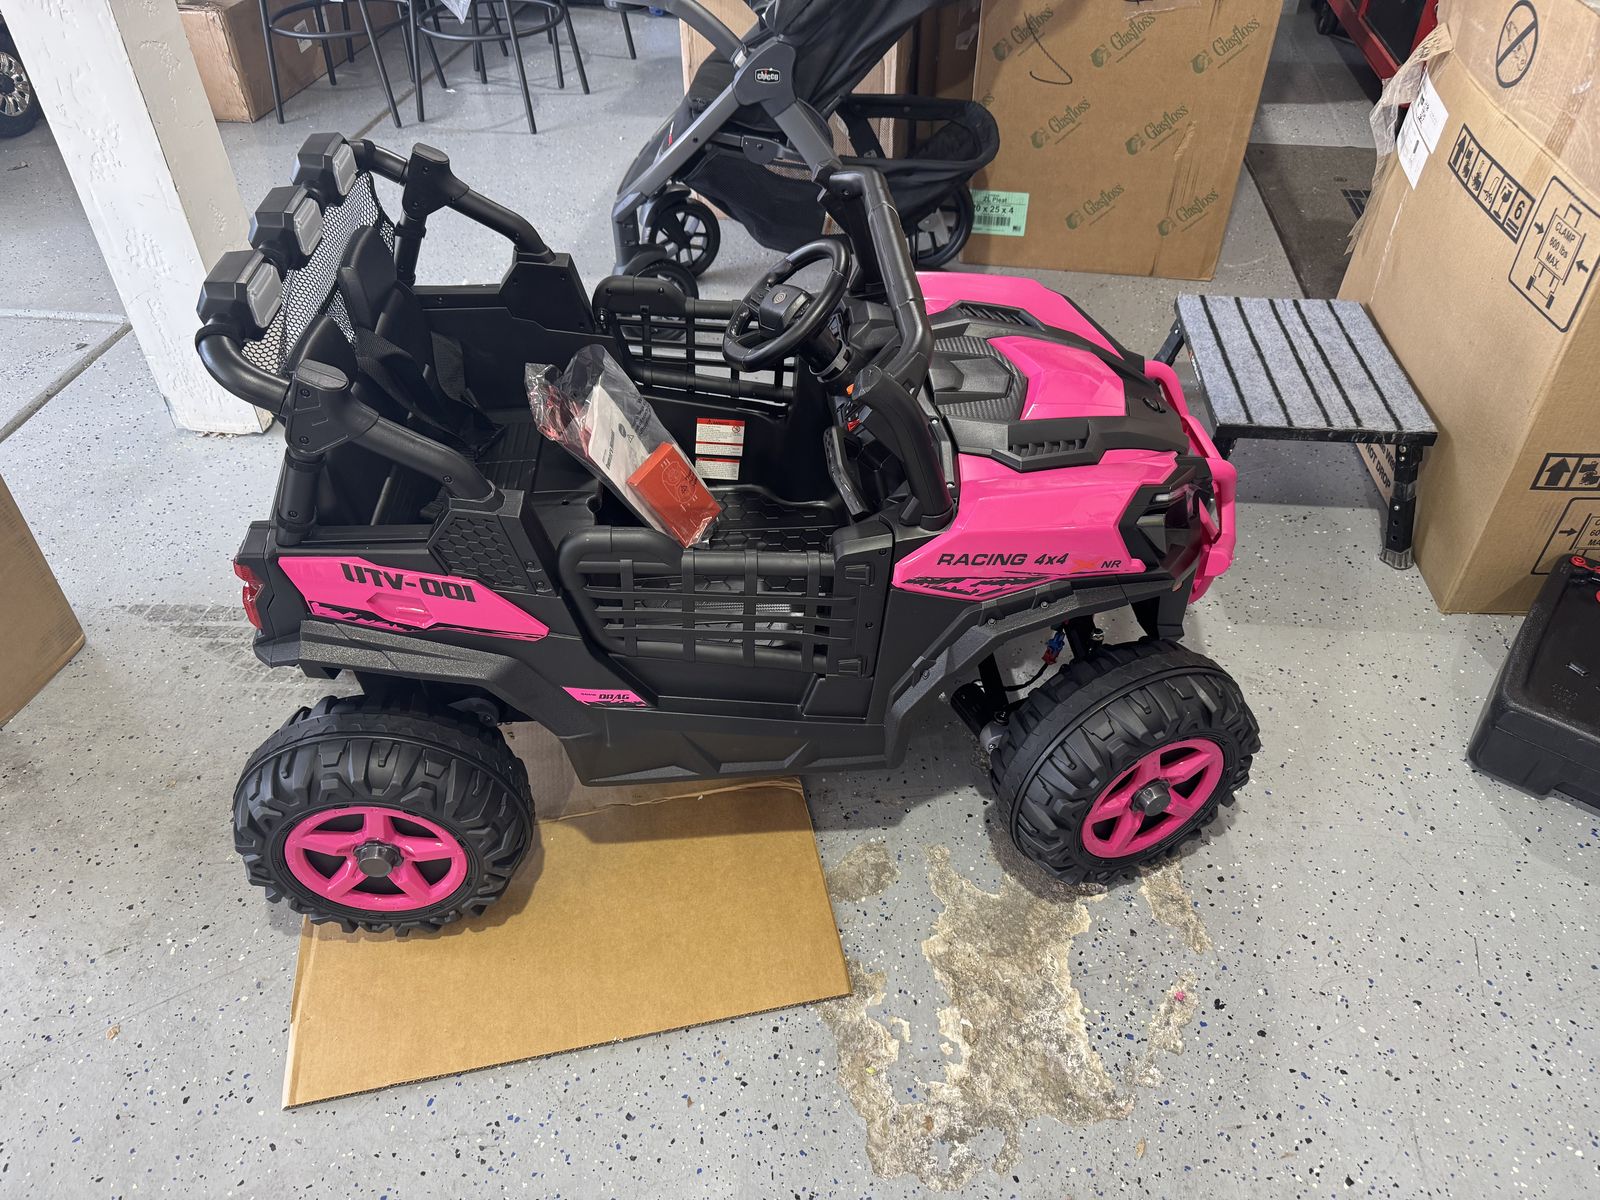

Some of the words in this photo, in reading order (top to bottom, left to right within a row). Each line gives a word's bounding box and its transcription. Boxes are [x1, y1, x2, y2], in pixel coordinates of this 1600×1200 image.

[1111, 14, 1156, 50] Glasfloss
[1212, 18, 1260, 56] Glasfloss
[757, 70, 778, 80] chicco
[1048, 99, 1091, 134] Glasfloss
[1144, 105, 1188, 139] Glasfloss
[990, 205, 1000, 213] 25
[1083, 184, 1125, 216] Glasfloss
[1175, 190, 1219, 222] Glasfloss
[1514, 200, 1525, 220] 6
[1555, 221, 1576, 243] CLAMP
[1375, 459, 1391, 489] DROP
[937, 553, 1028, 566] RACING
[1034, 552, 1069, 565] 4x4
[1100, 560, 1122, 569] NR
[340, 562, 477, 603] UTV-001
[598, 693, 630, 702] DRAG
